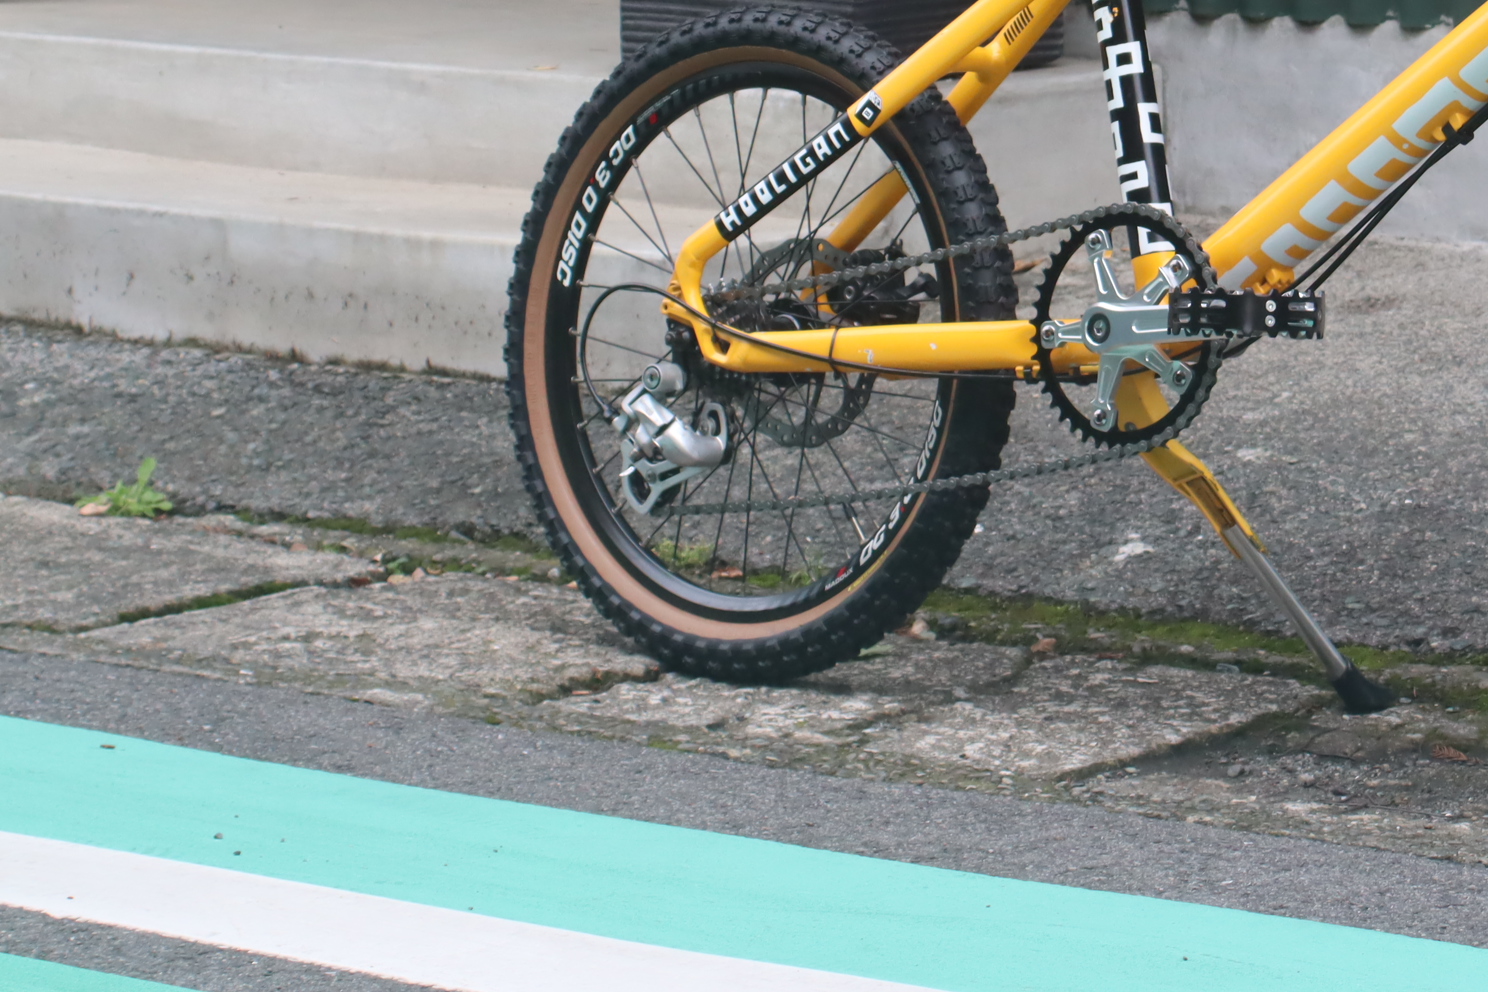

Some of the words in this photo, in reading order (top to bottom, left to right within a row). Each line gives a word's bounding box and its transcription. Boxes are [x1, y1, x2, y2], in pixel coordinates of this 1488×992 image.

[609, 124, 637, 165] DC
[719, 122, 850, 231] HOOLIGAN
[556, 210, 587, 287] DISC
